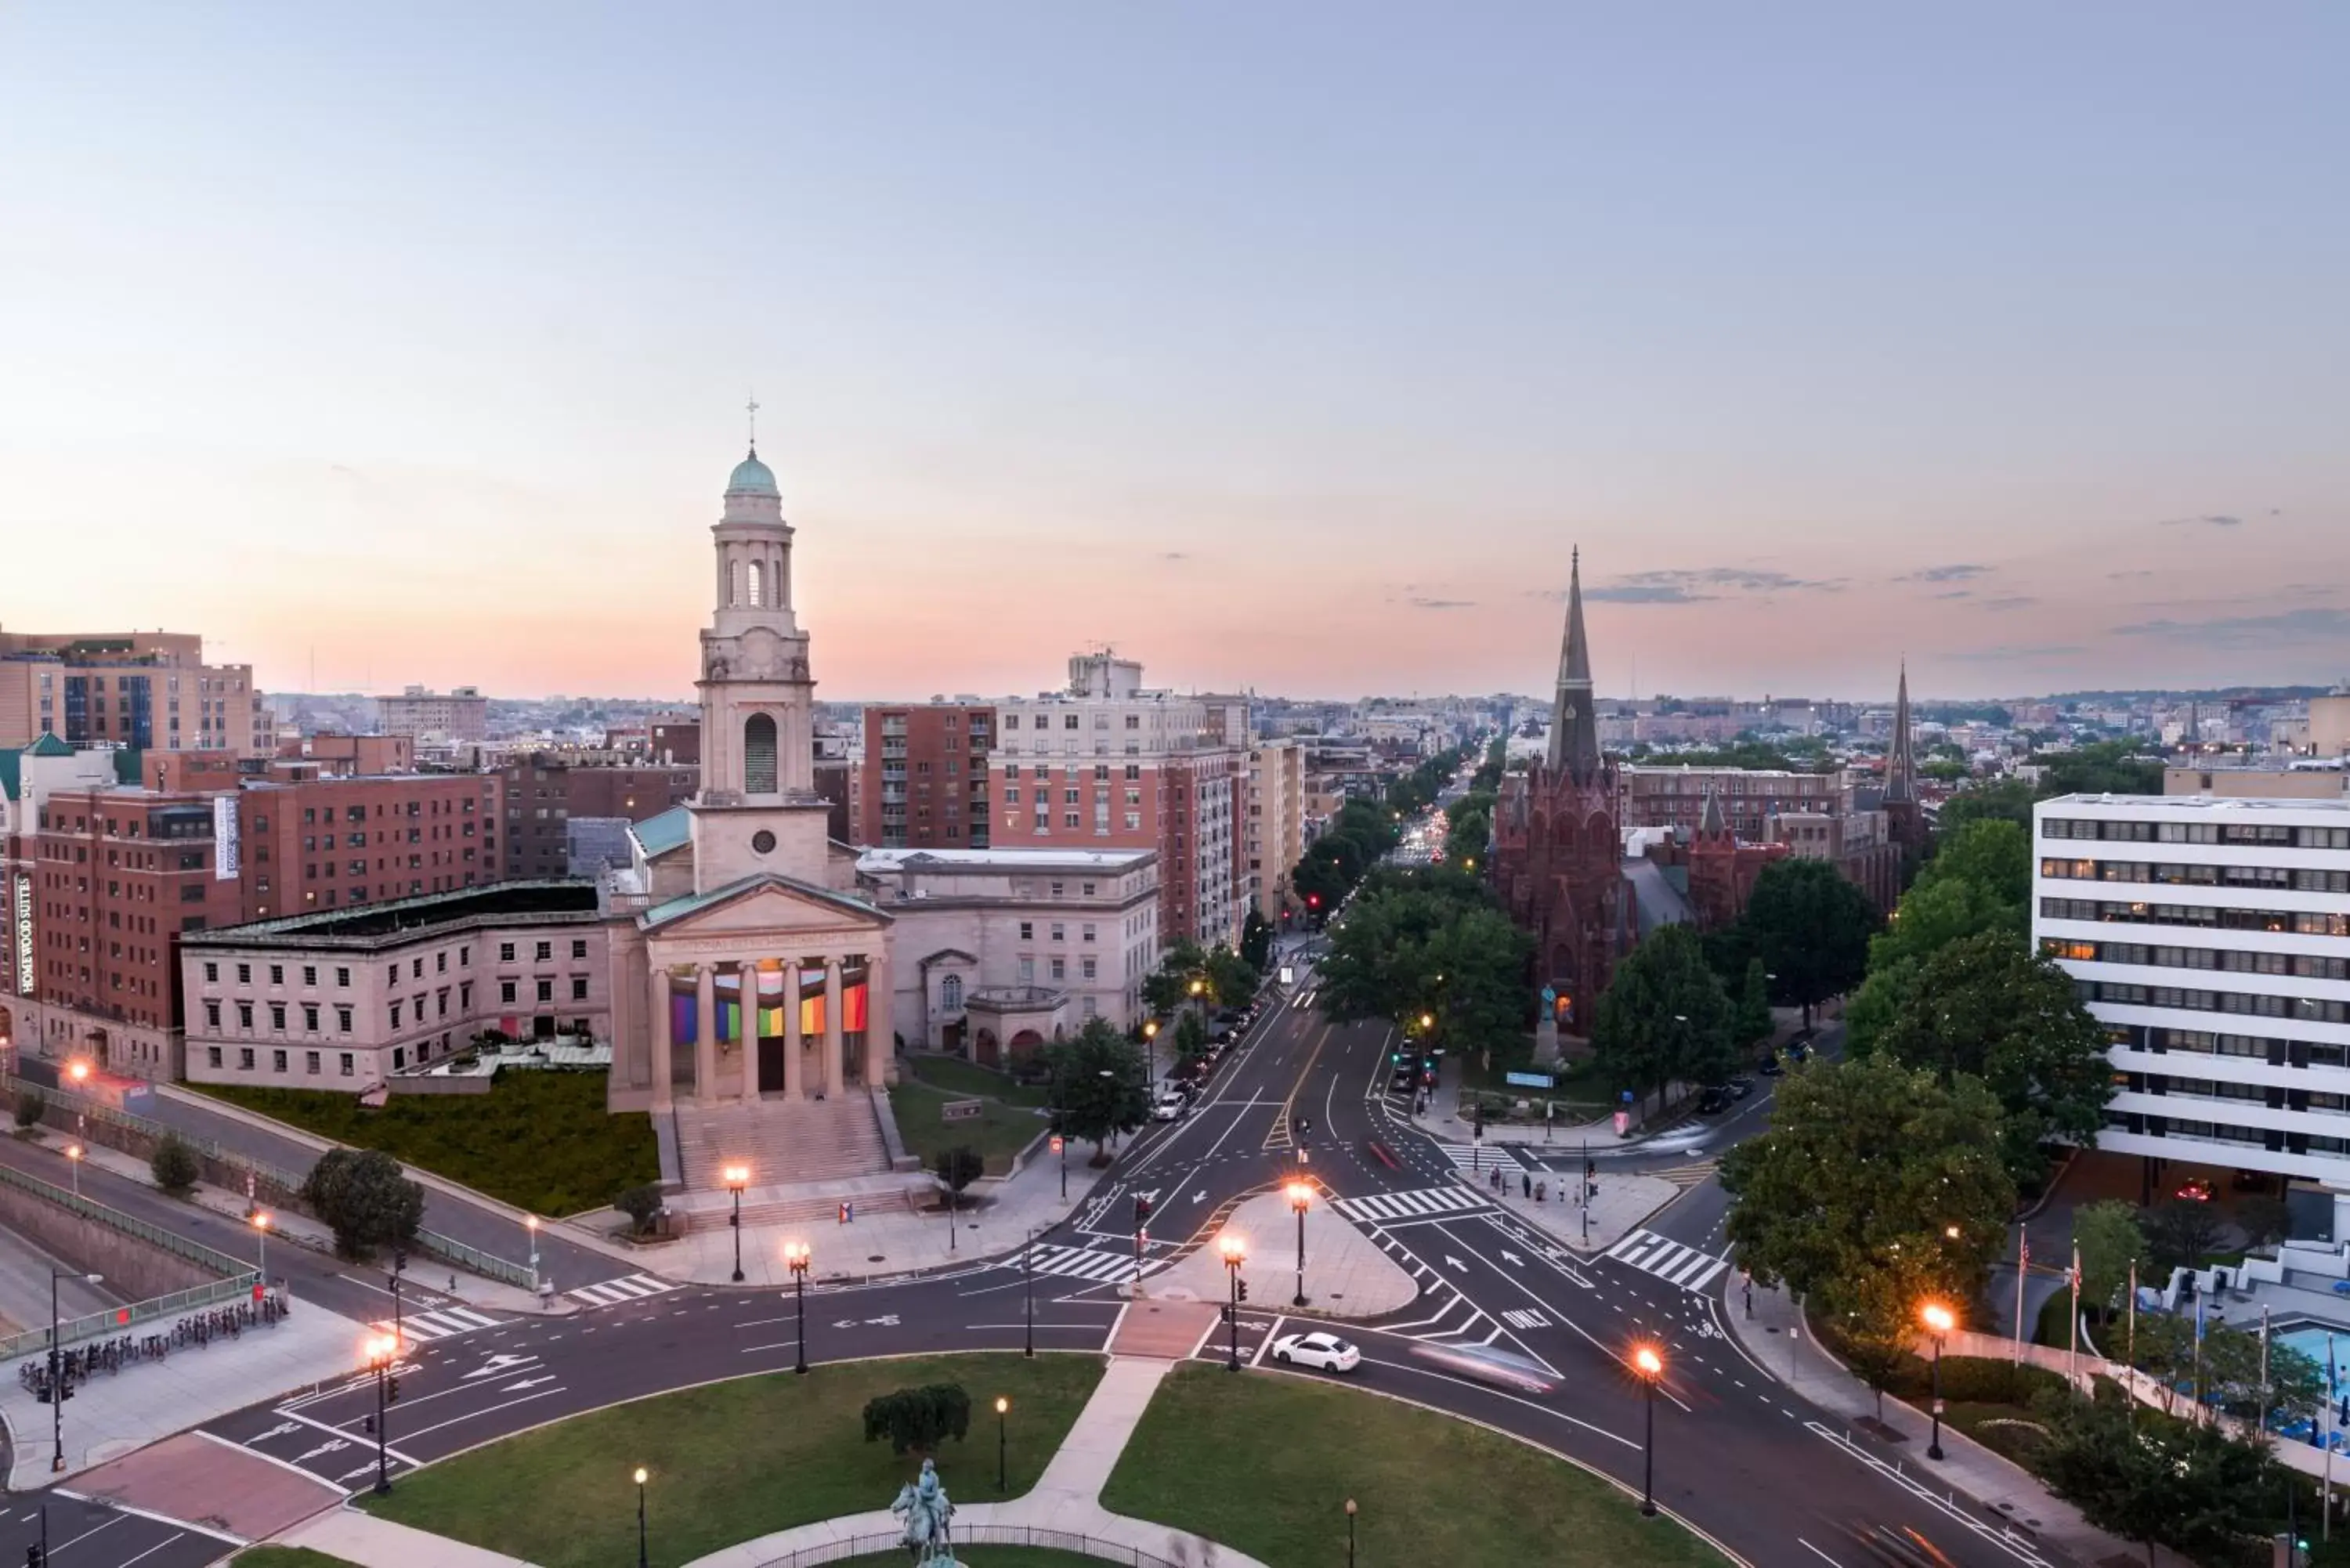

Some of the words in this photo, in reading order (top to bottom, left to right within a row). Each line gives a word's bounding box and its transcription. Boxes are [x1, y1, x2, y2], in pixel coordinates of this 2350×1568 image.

[19, 878, 31, 918] SUITES
[20, 919, 34, 993] HOMEWOOD
[1501, 1309, 1553, 1329] ONLY
